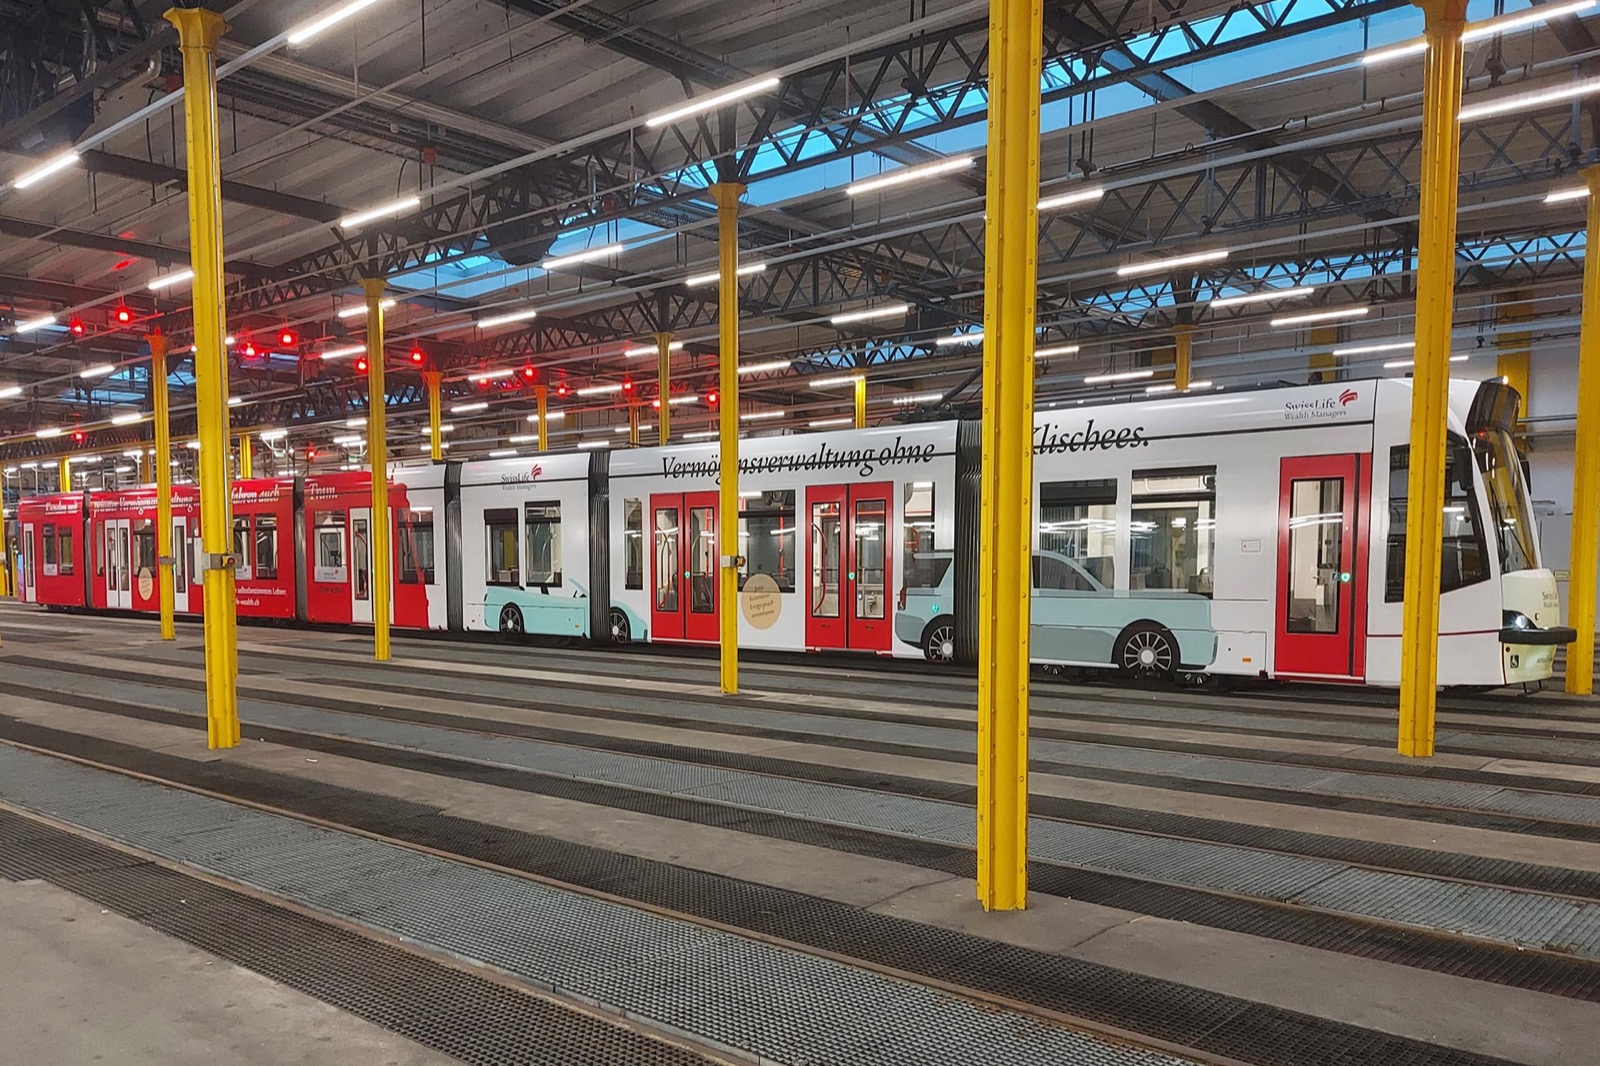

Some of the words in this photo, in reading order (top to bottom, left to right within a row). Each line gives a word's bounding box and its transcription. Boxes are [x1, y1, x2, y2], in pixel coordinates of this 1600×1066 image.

[1285, 398, 1336, 410] SwissLife
[1284, 411, 1309, 420] Wealth
[1311, 410, 1347, 419] Managers
[661, 443, 876, 485] Vermönsverwaltung
[878, 436, 936, 466] ohne
